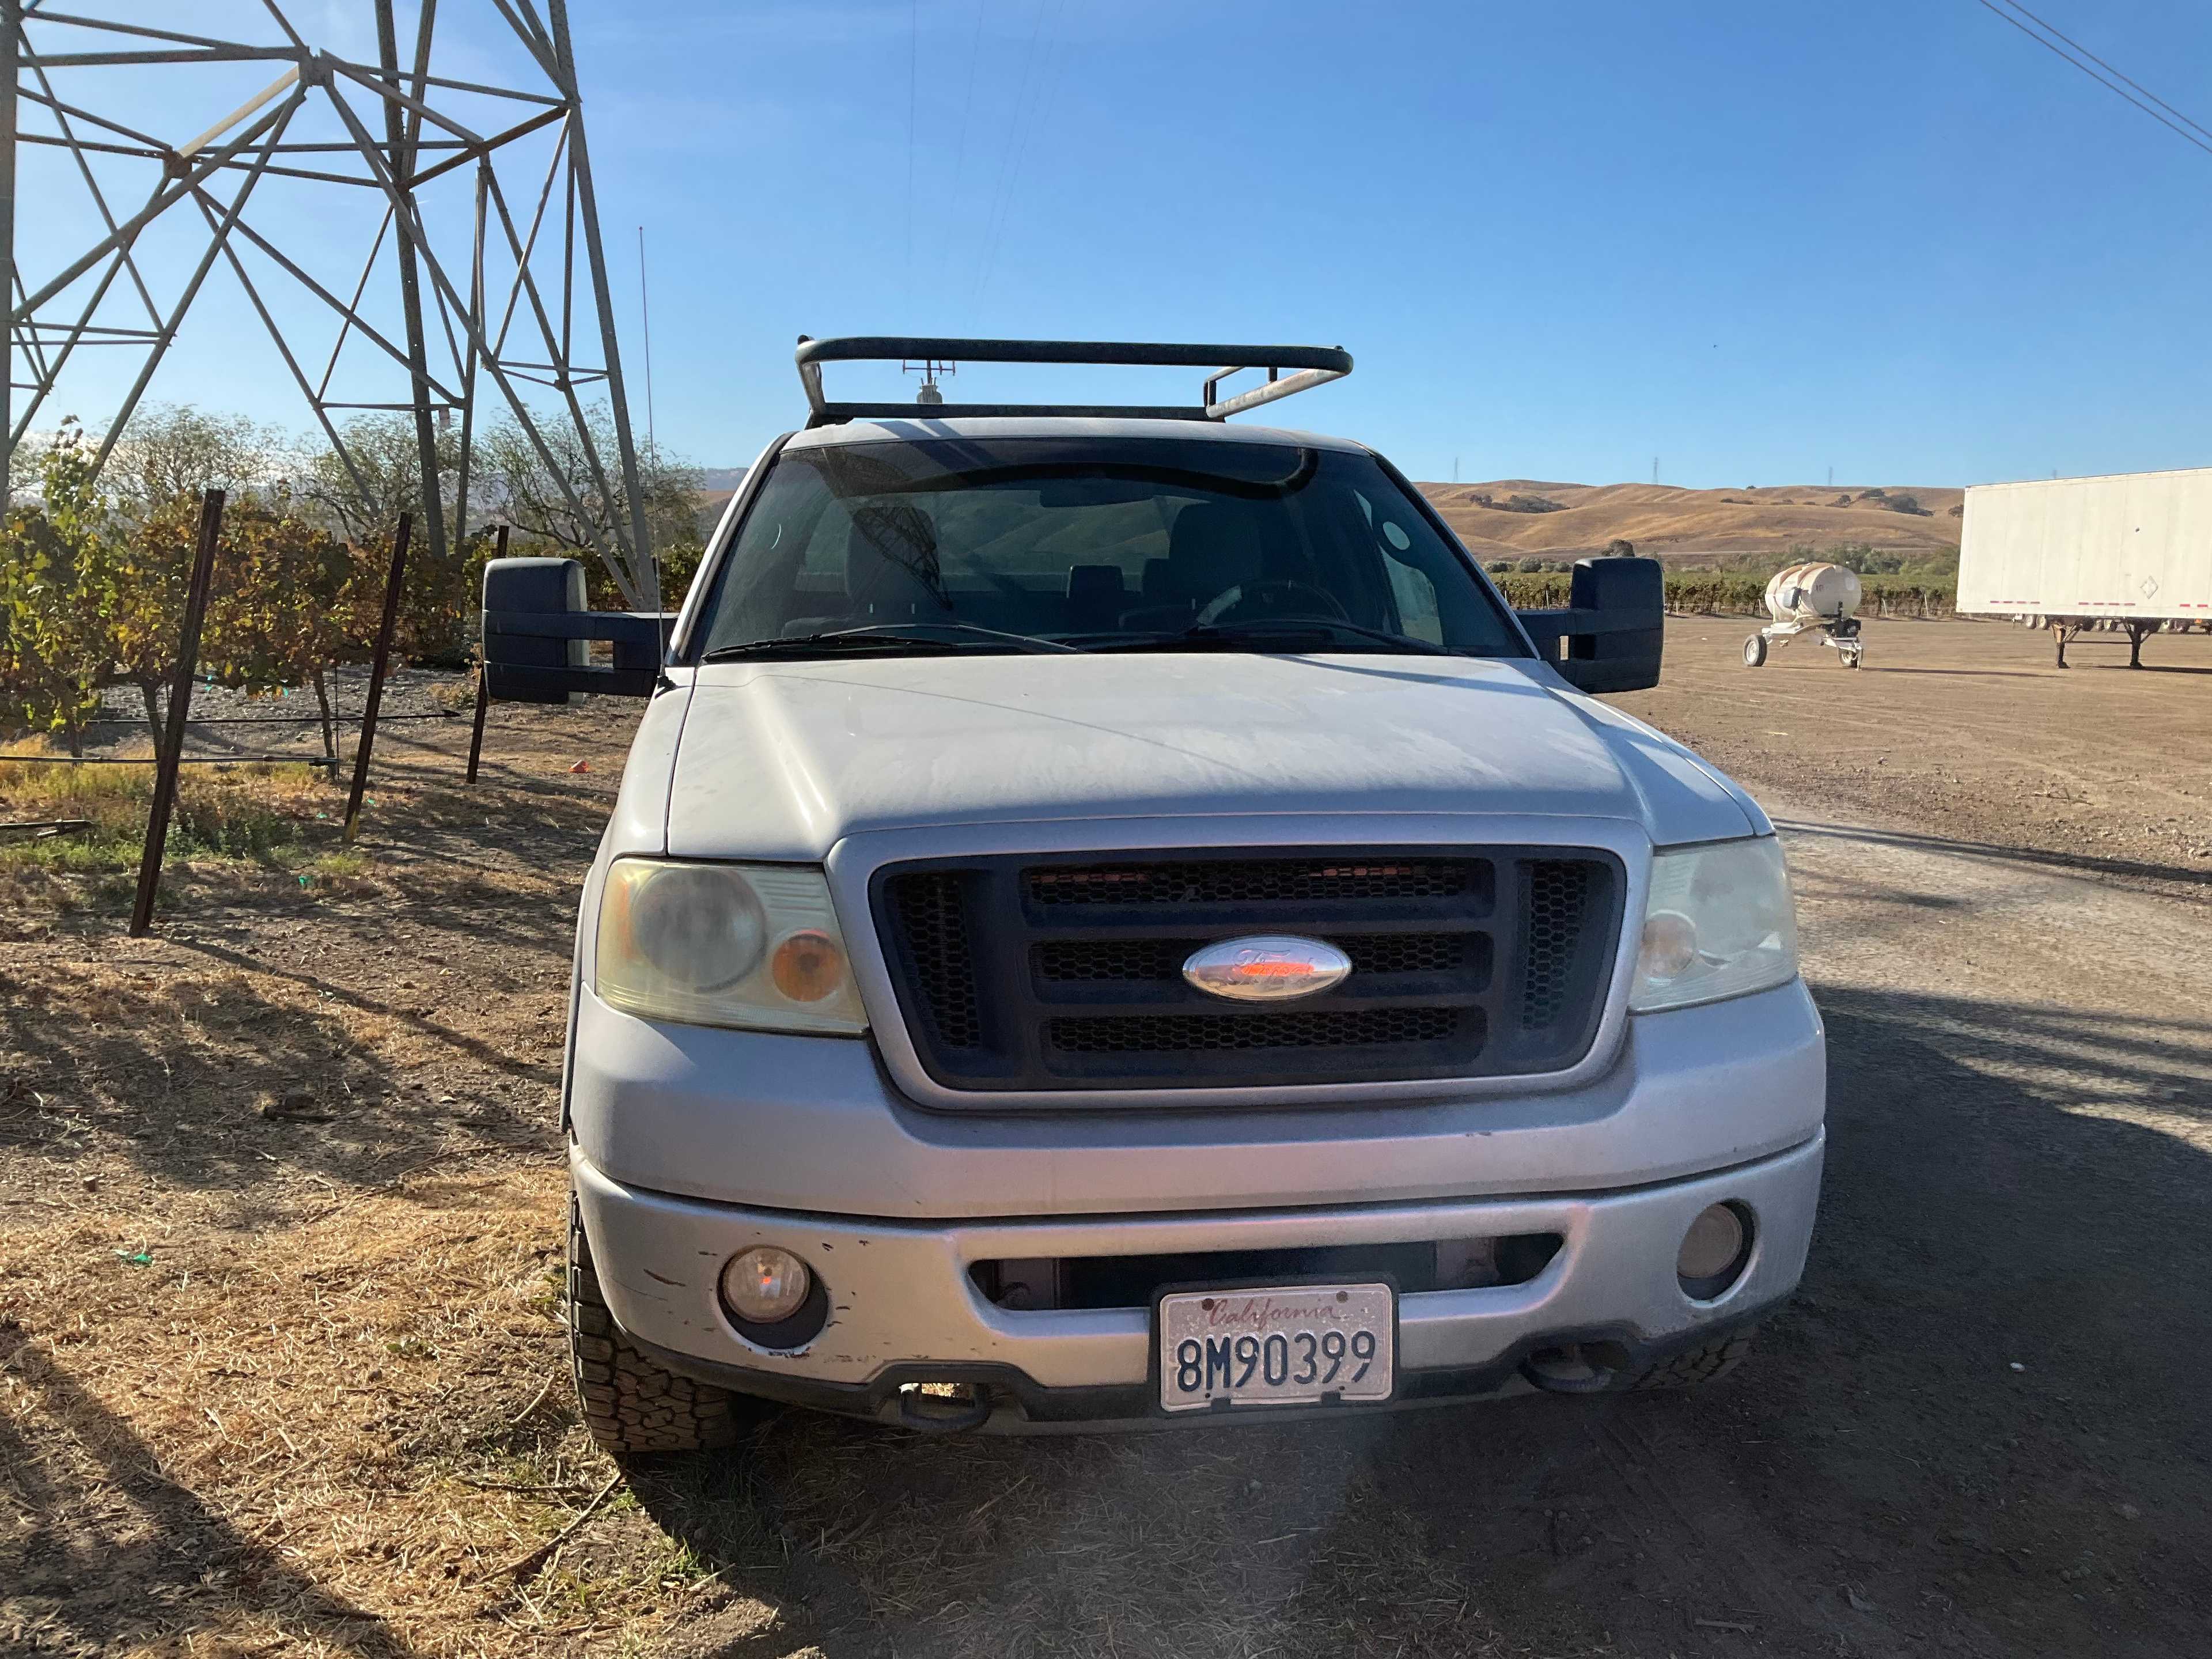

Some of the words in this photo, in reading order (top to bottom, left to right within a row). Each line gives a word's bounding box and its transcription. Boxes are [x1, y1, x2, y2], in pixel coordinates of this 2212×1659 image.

[1209, 948, 1317, 986] Ford
[1209, 1297, 1343, 1330] California
[1177, 1330, 1376, 1392] 8M90399
